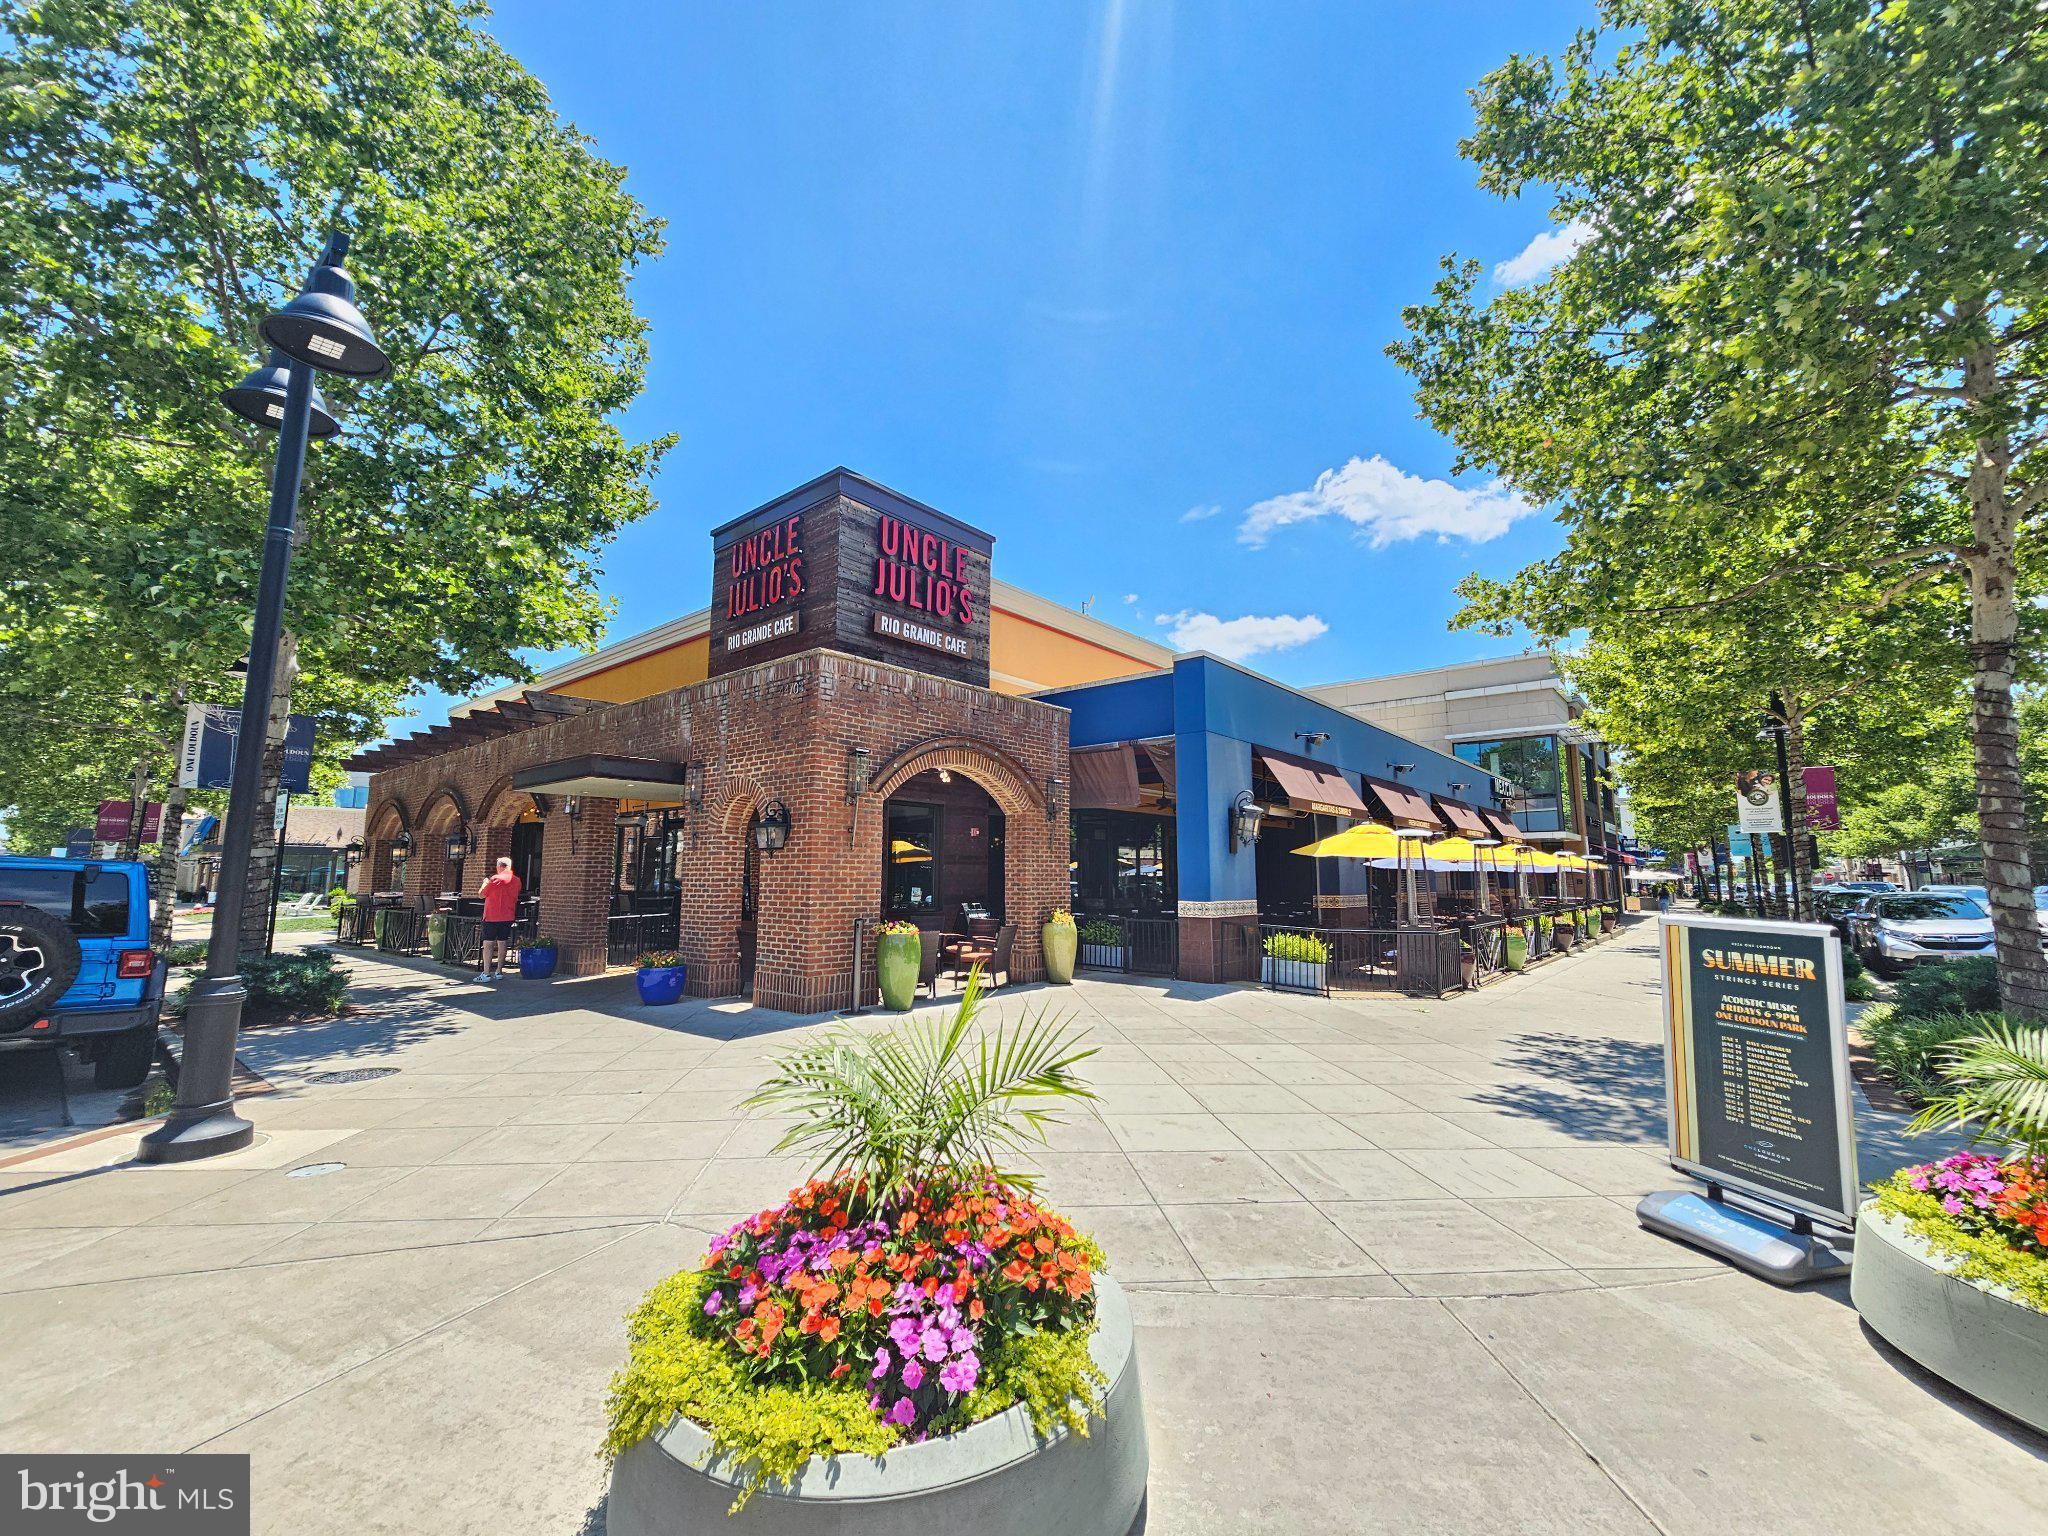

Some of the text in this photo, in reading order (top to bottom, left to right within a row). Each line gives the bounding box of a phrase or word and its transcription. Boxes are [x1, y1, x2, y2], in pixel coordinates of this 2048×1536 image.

[732, 516, 800, 578] UNCLE
[881, 515, 970, 584] UNCLE
[727, 558, 802, 620] JULIO'S
[875, 558, 973, 624] JULIO'S
[727, 616, 794, 650] RIO GRANDE CAFE
[881, 616, 967, 654] RIO GRANDE CAFE
[185, 721, 199, 772] ONE LOUDOUN
[1701, 948, 1816, 981] SUMMER
[1714, 974, 1799, 991] STRINGS SERIES
[1715, 1010, 1807, 1033] ONE LOUDOUN PARK
[1720, 1002, 1800, 1022] FRIDAYS 6-9PM
[1721, 994, 1797, 1013] ACOUSTIC MUSIC
